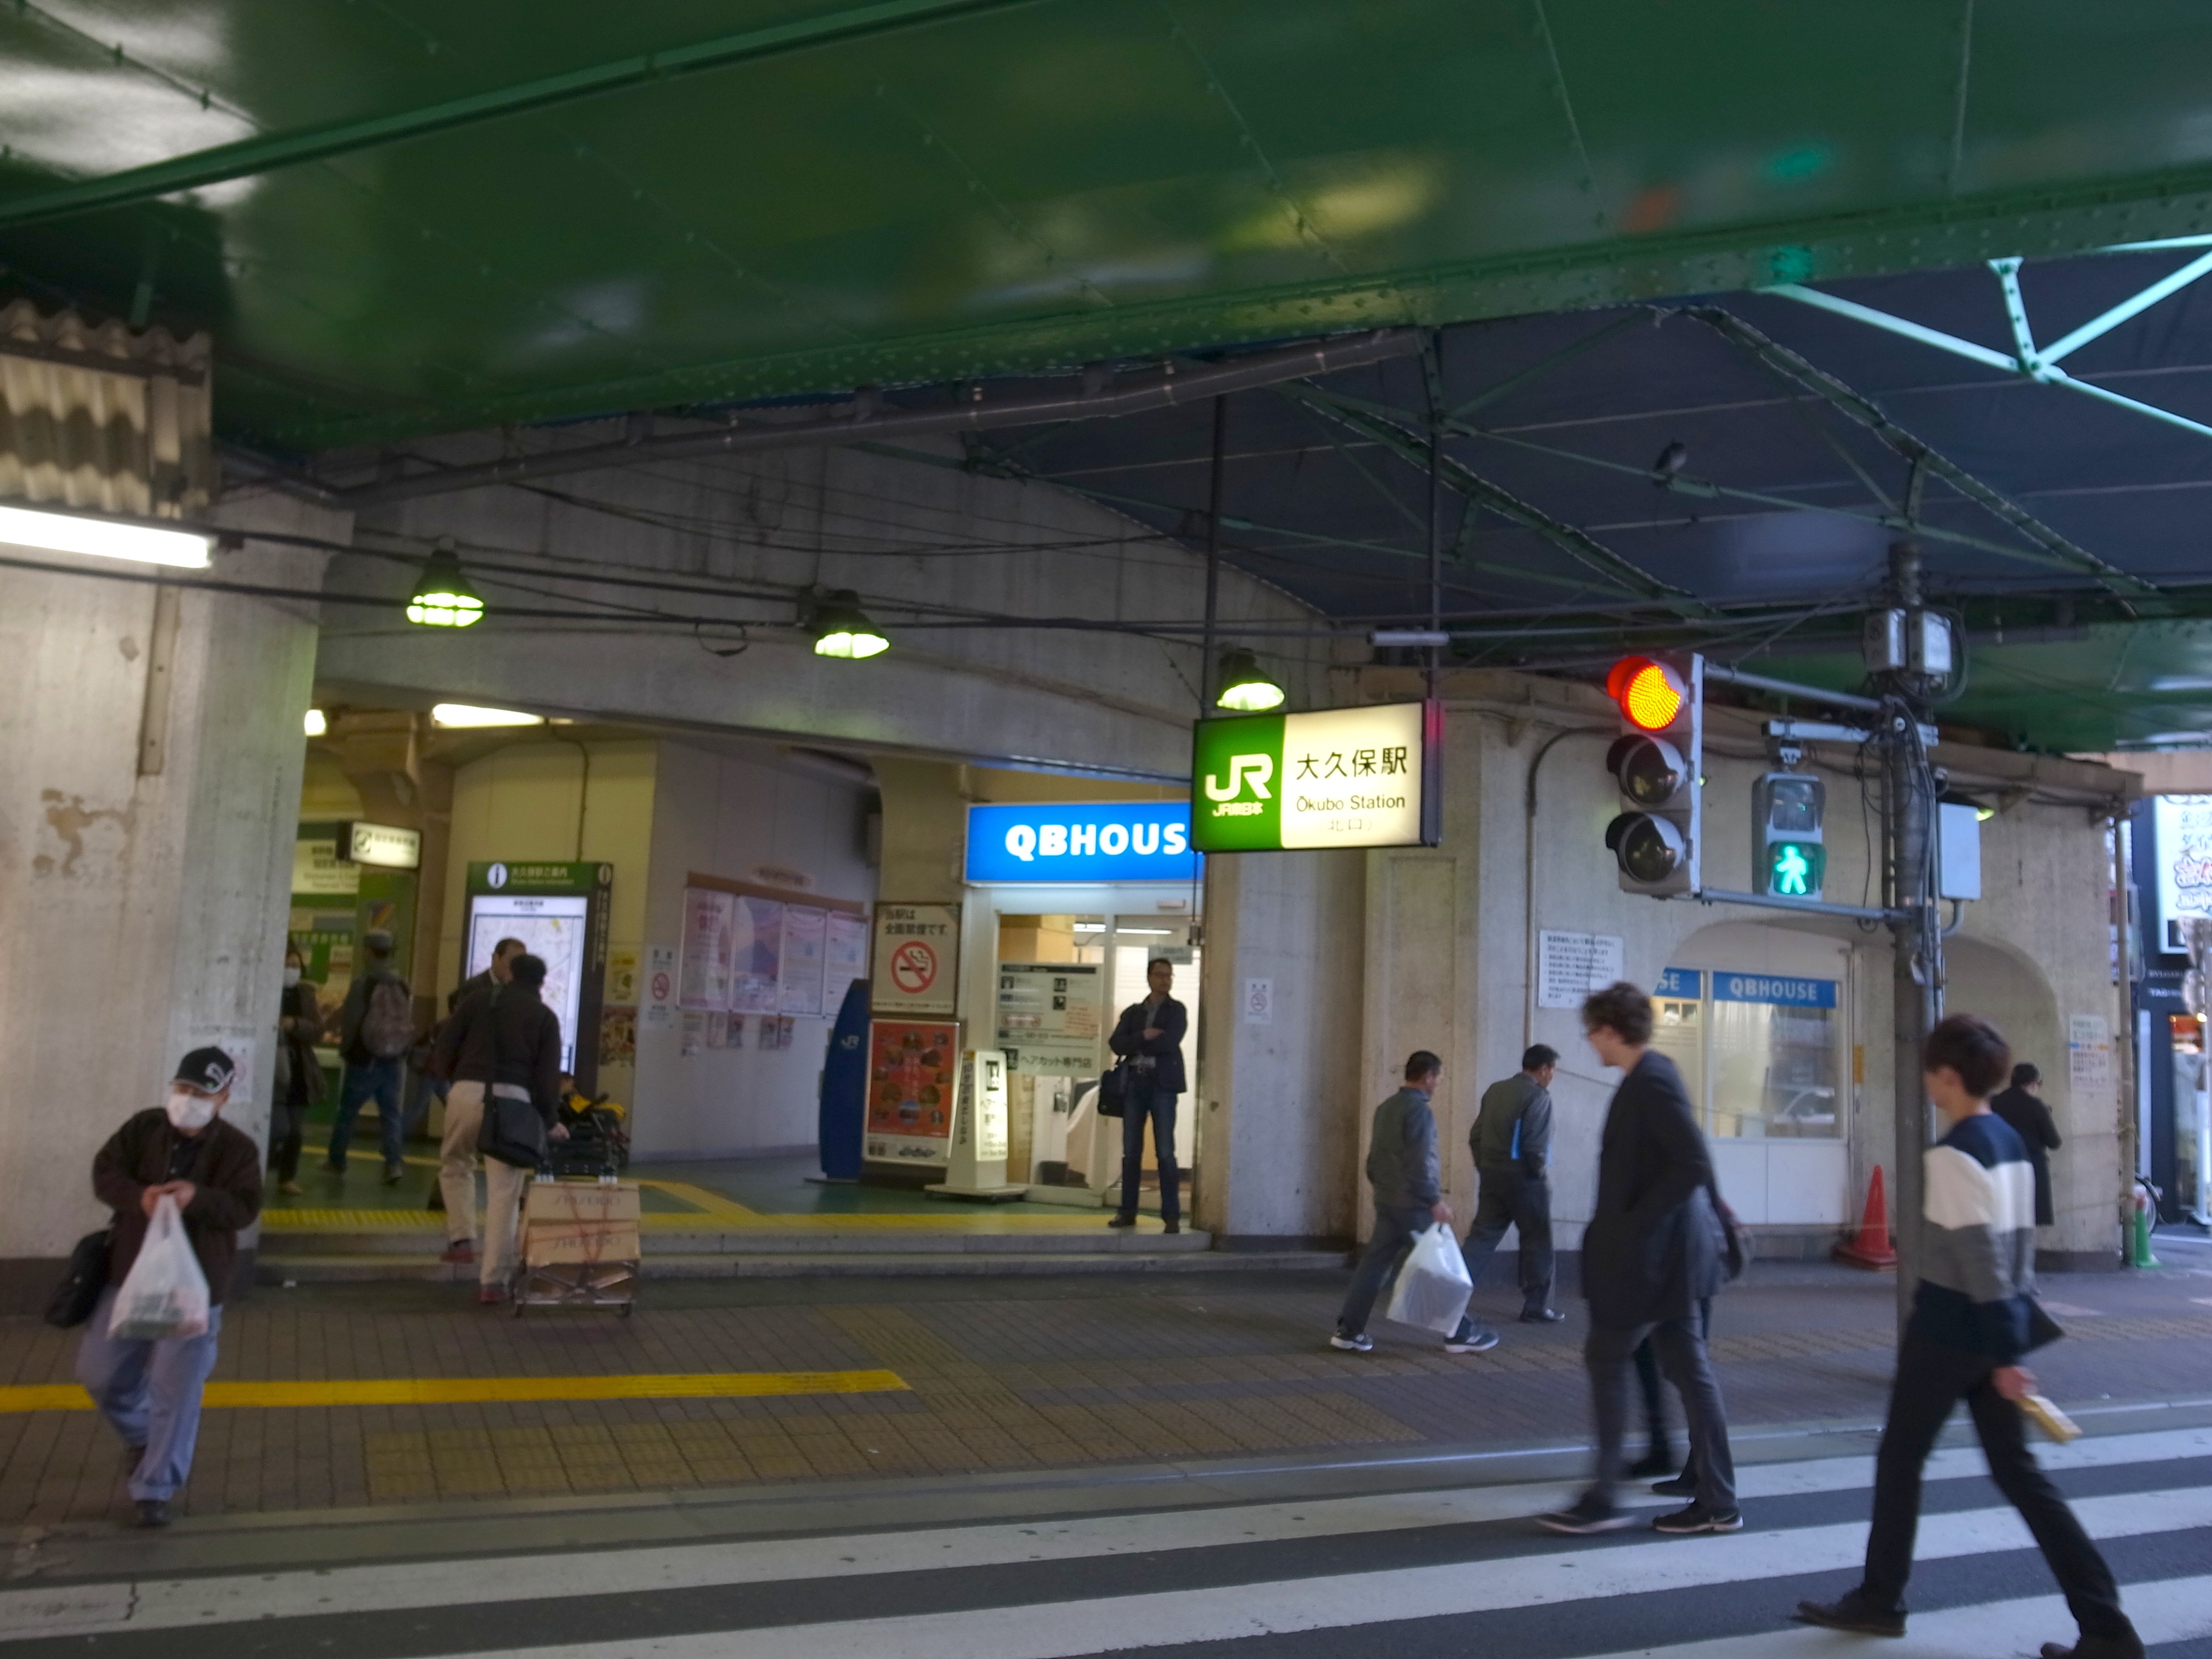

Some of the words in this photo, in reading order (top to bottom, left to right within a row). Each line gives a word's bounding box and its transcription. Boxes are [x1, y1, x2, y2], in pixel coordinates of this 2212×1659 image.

[1296, 746, 1407, 780] 大久保駅
[1205, 753, 1273, 802] JR
[1213, 802, 1263, 817] JR東日本
[1350, 794, 1406, 809] Station
[1005, 823, 1187, 861] QBHOUS
[1730, 977, 1818, 1000] QBHOUSE
[1021, 1055, 1091, 1069] ヘアカット専門店
